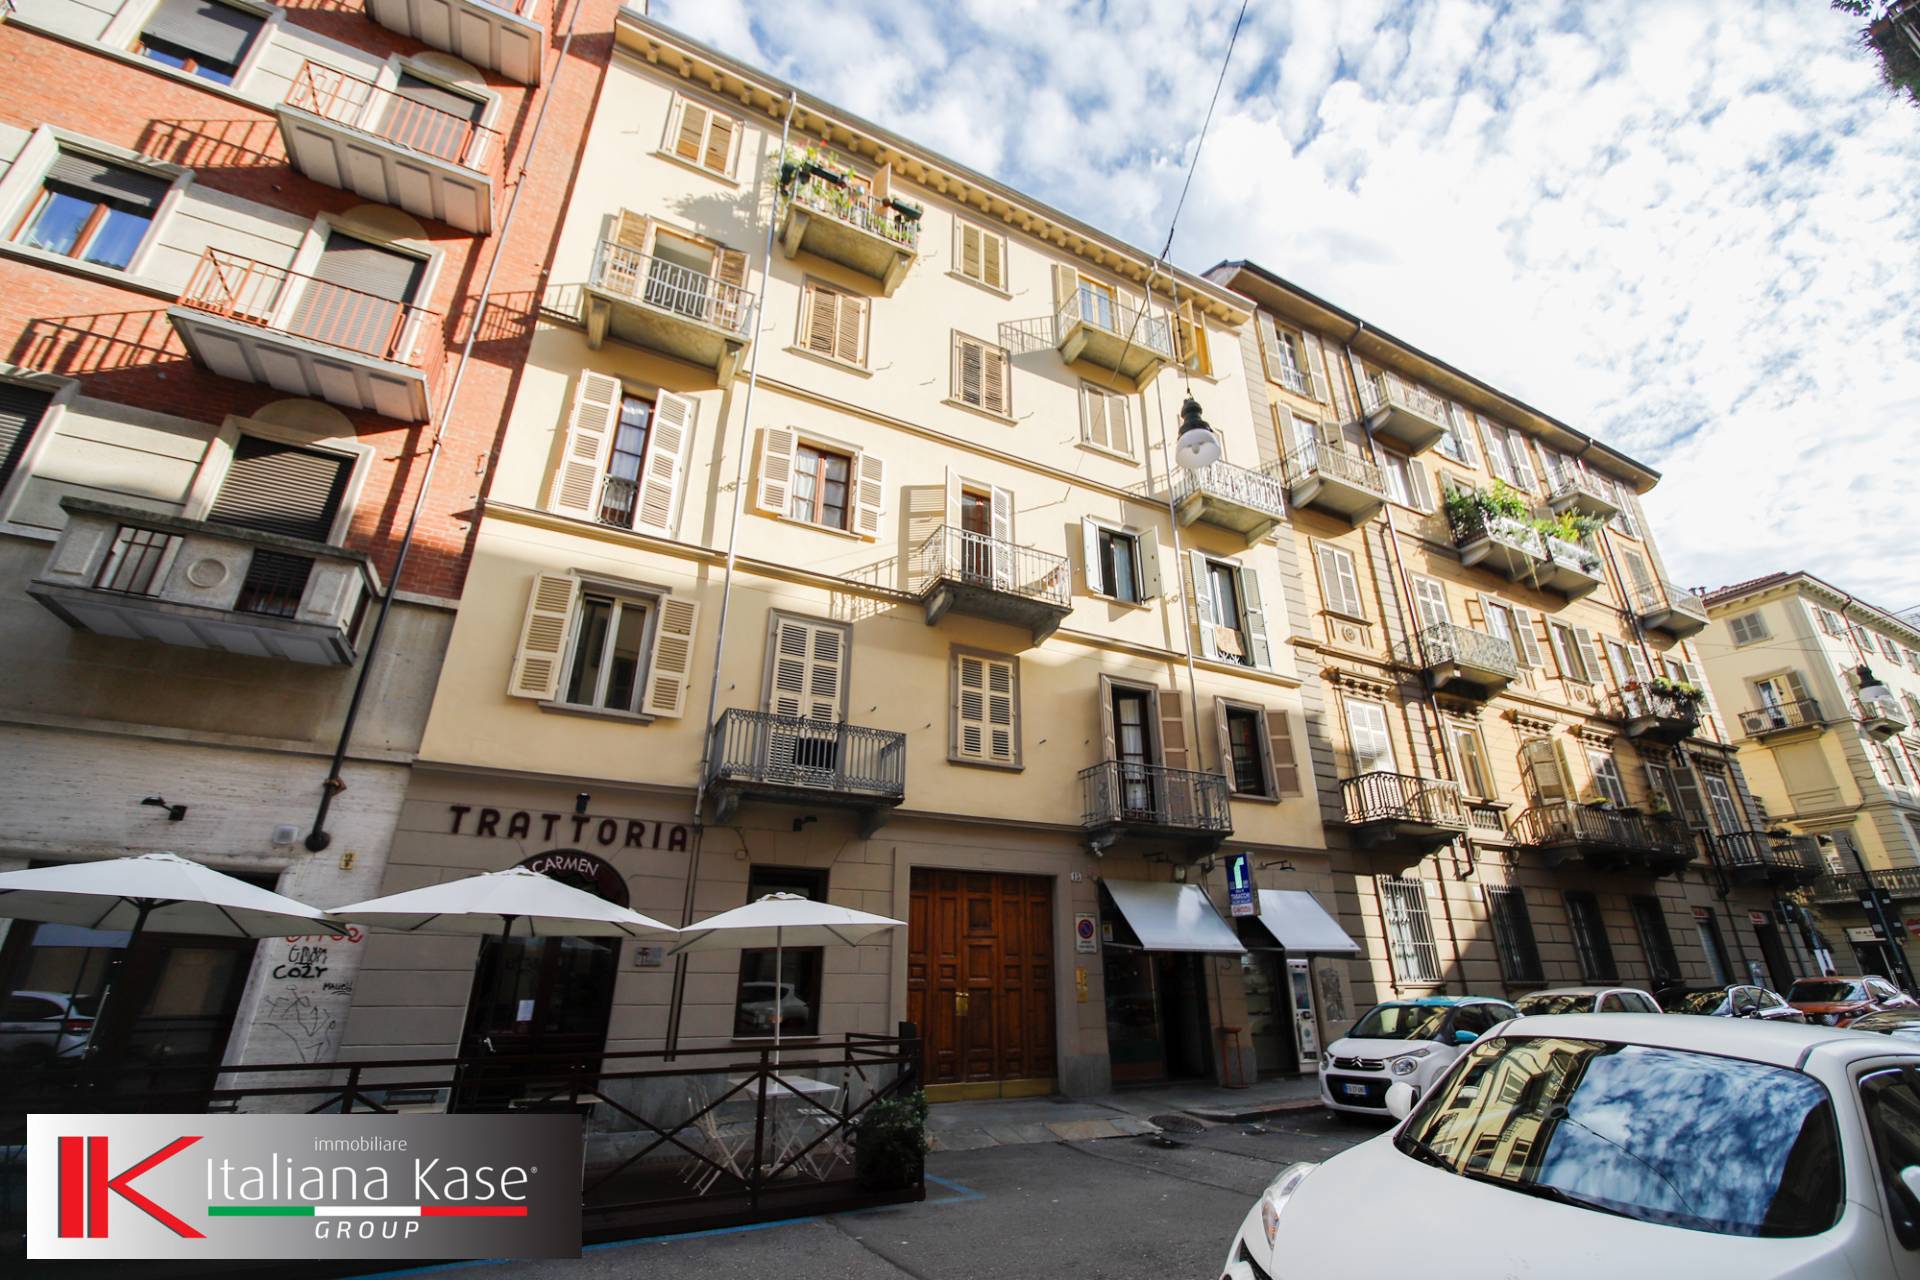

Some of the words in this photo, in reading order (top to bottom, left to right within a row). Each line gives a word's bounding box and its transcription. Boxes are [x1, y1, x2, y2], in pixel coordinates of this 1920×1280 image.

[449, 805, 688, 852] TRATTORIA
[532, 855, 600, 877] CARMEN
[272, 964, 328, 980] COZY
